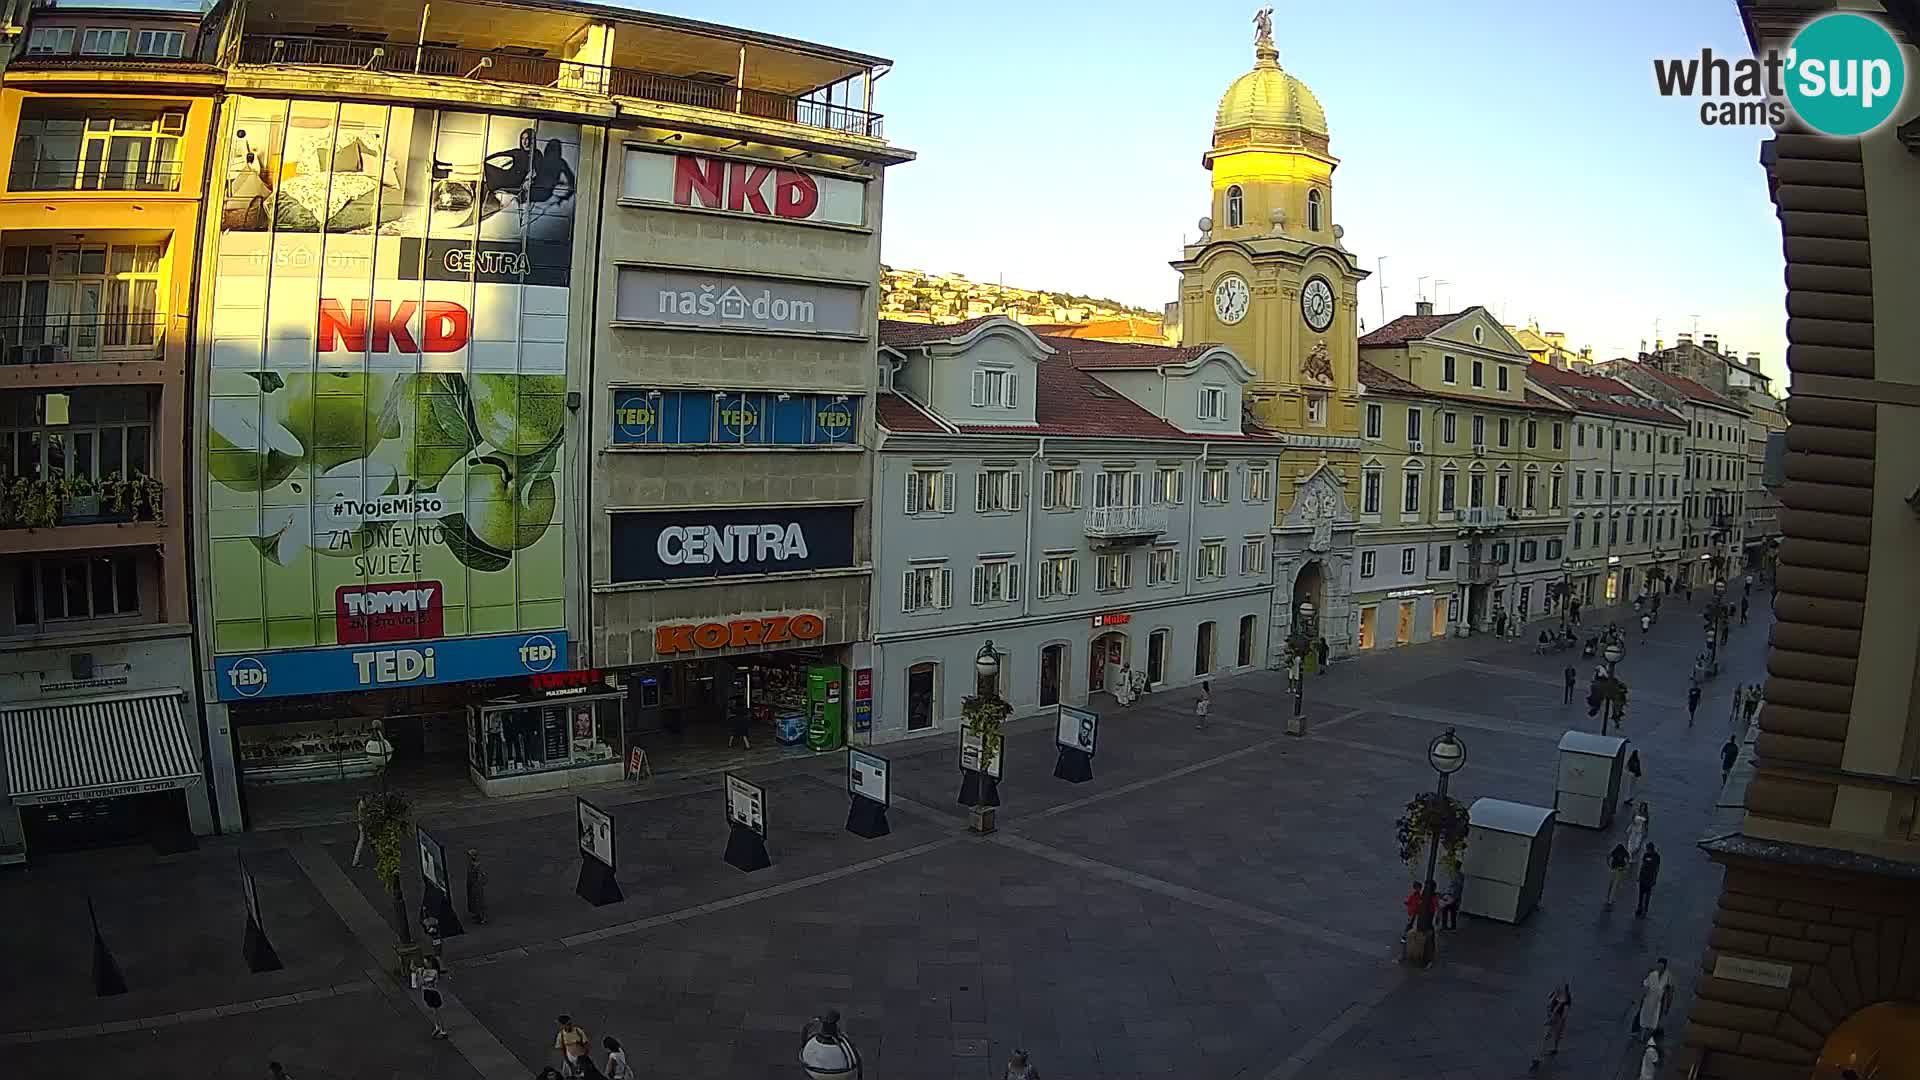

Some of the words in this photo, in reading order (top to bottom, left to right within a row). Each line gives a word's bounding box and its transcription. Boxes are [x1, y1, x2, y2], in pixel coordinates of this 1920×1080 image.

[675, 155, 819, 219] NKD
[444, 249, 531, 275] CENTRA
[659, 284, 715, 316] naš
[752, 289, 815, 323] dom
[317, 297, 470, 354] NKD
[615, 408, 656, 426] TEDi
[721, 408, 758, 427] TEDi
[817, 410, 852, 428] TEDi
[333, 497, 442, 517] #TvojeMisto
[328, 530, 353, 550] ZA
[361, 526, 447, 550] DNEVNO
[657, 522, 808, 566] CENTRA
[354, 549, 422, 577] SVJEŽE
[343, 588, 435, 616] TOMMY
[656, 613, 824, 655] KORZO
[352, 647, 436, 684] TEDi
[519, 642, 557, 664] TEDi
[228, 667, 268, 686] TEDi
